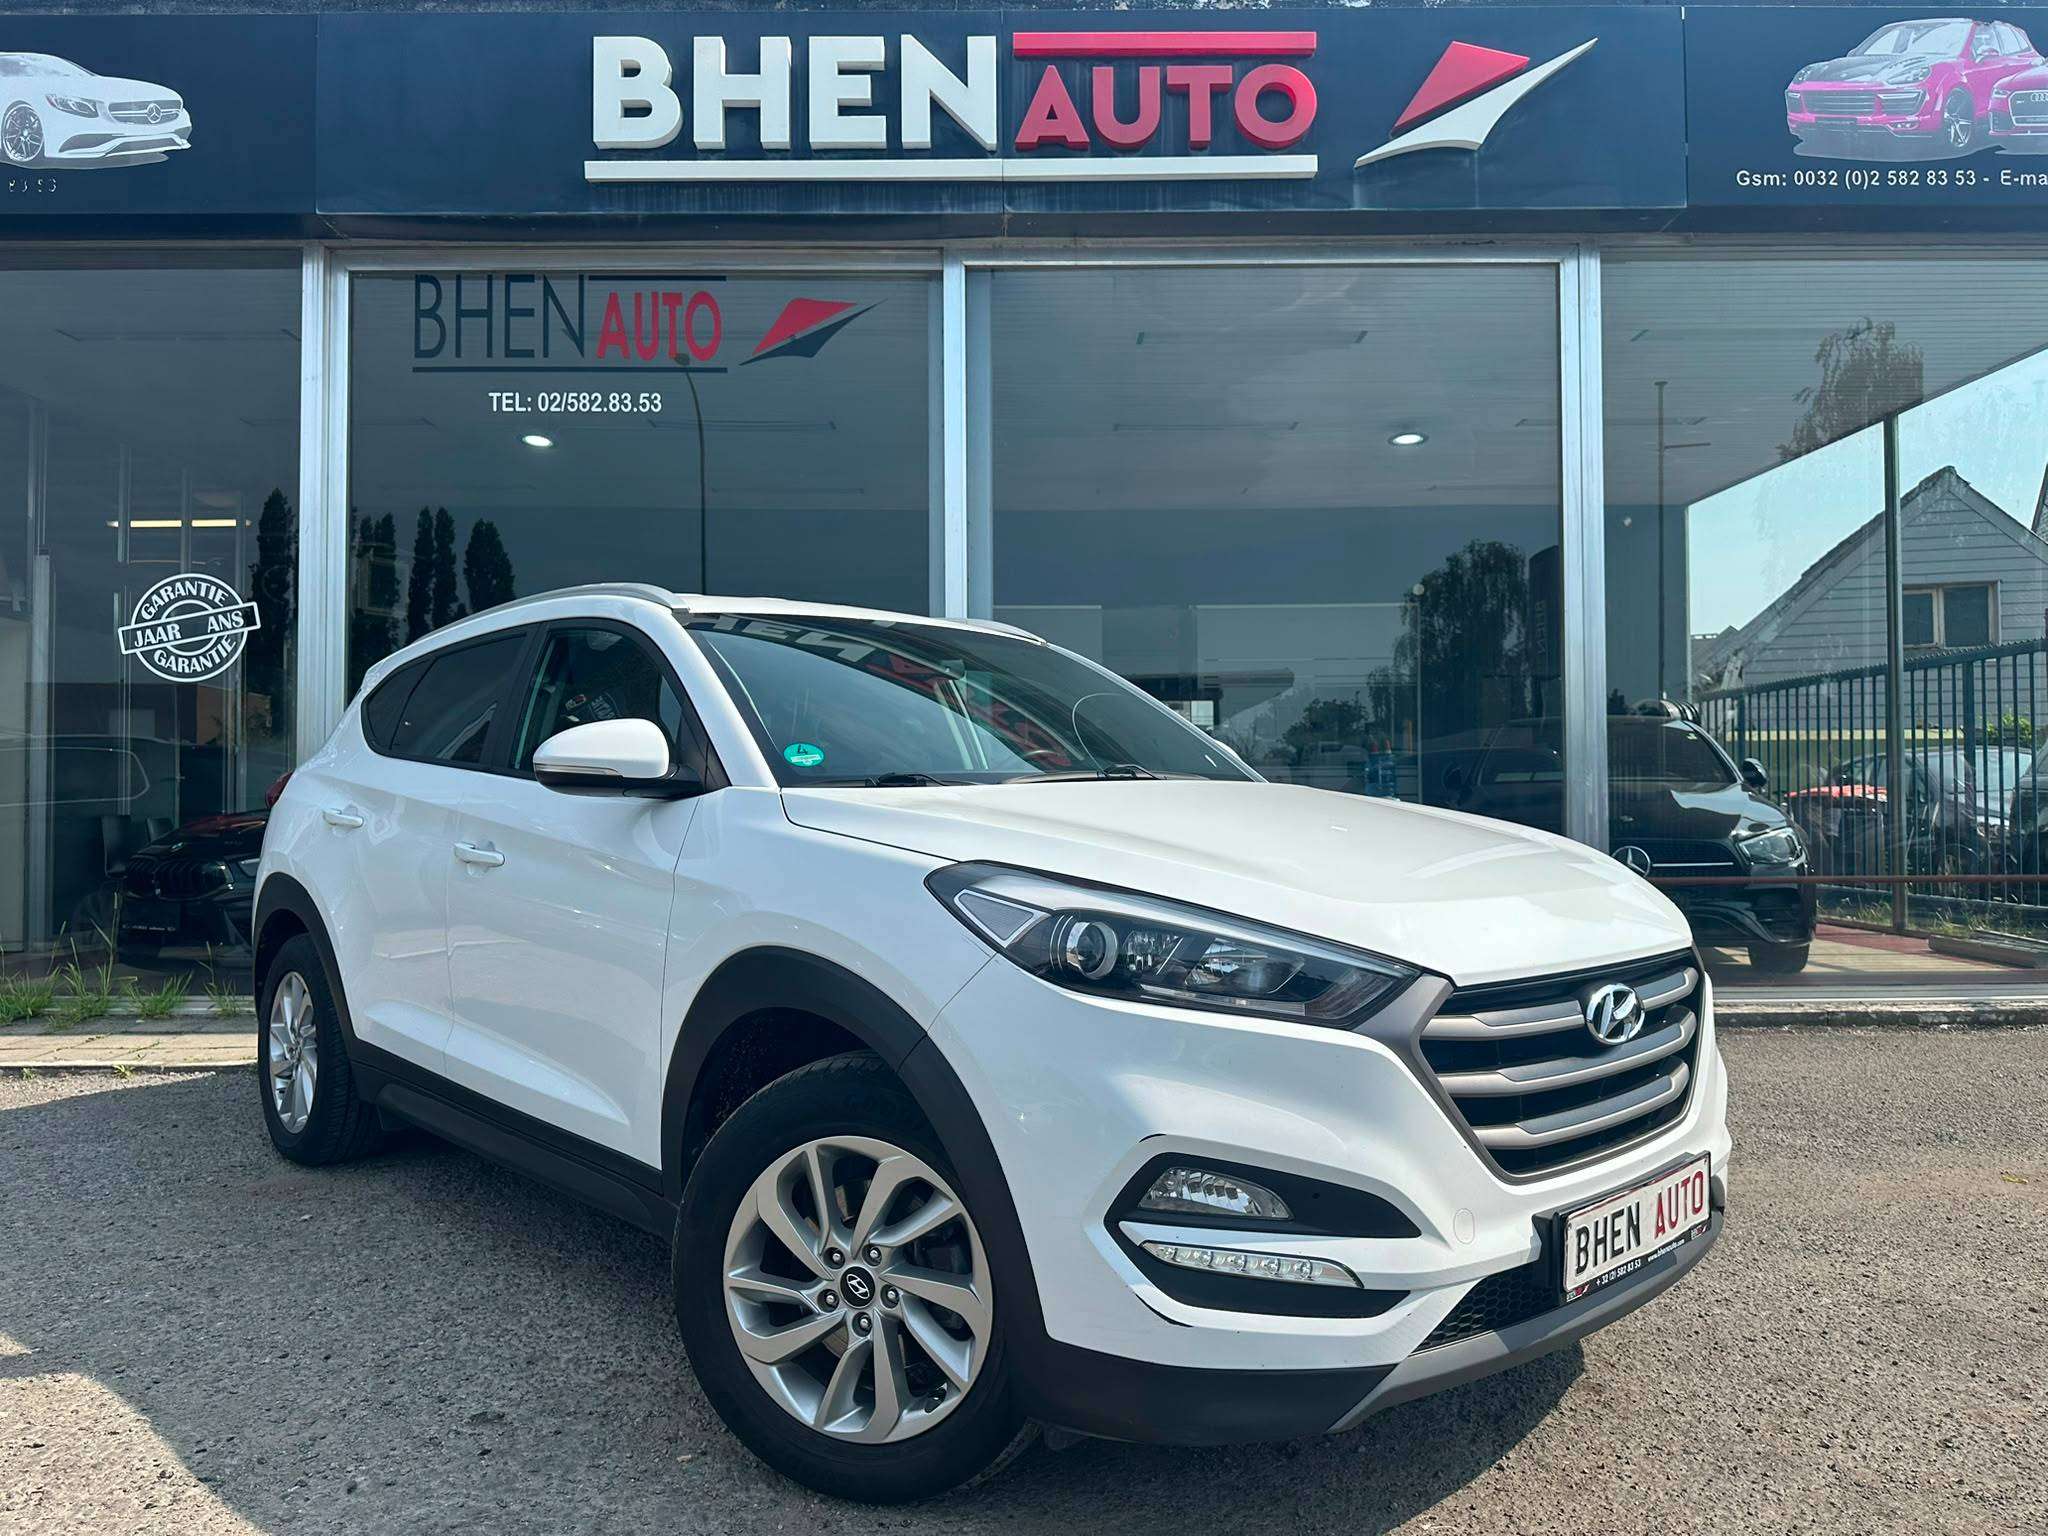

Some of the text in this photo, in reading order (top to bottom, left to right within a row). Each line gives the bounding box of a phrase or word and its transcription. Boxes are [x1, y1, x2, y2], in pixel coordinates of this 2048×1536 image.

[592, 34, 1318, 152] BHEN AUTO
[1736, 170, 1787, 187] Gsm:
[1793, 170, 1838, 187] 0032
[1845, 169, 1880, 190] (0)2
[1887, 170, 1920, 187] 582
[1926, 170, 1948, 187] 83
[1955, 170, 1977, 187] 53
[413, 274, 723, 362] BHEN AUTO
[489, 391, 662, 414] TEL: 02/582.83.53
[140, 580, 229, 620] GARANTIE
[134, 610, 245, 648] JAAR ANS
[154, 636, 237, 674] GARANTIE
[1575, 1171, 1704, 1276] BHEN AUTO
